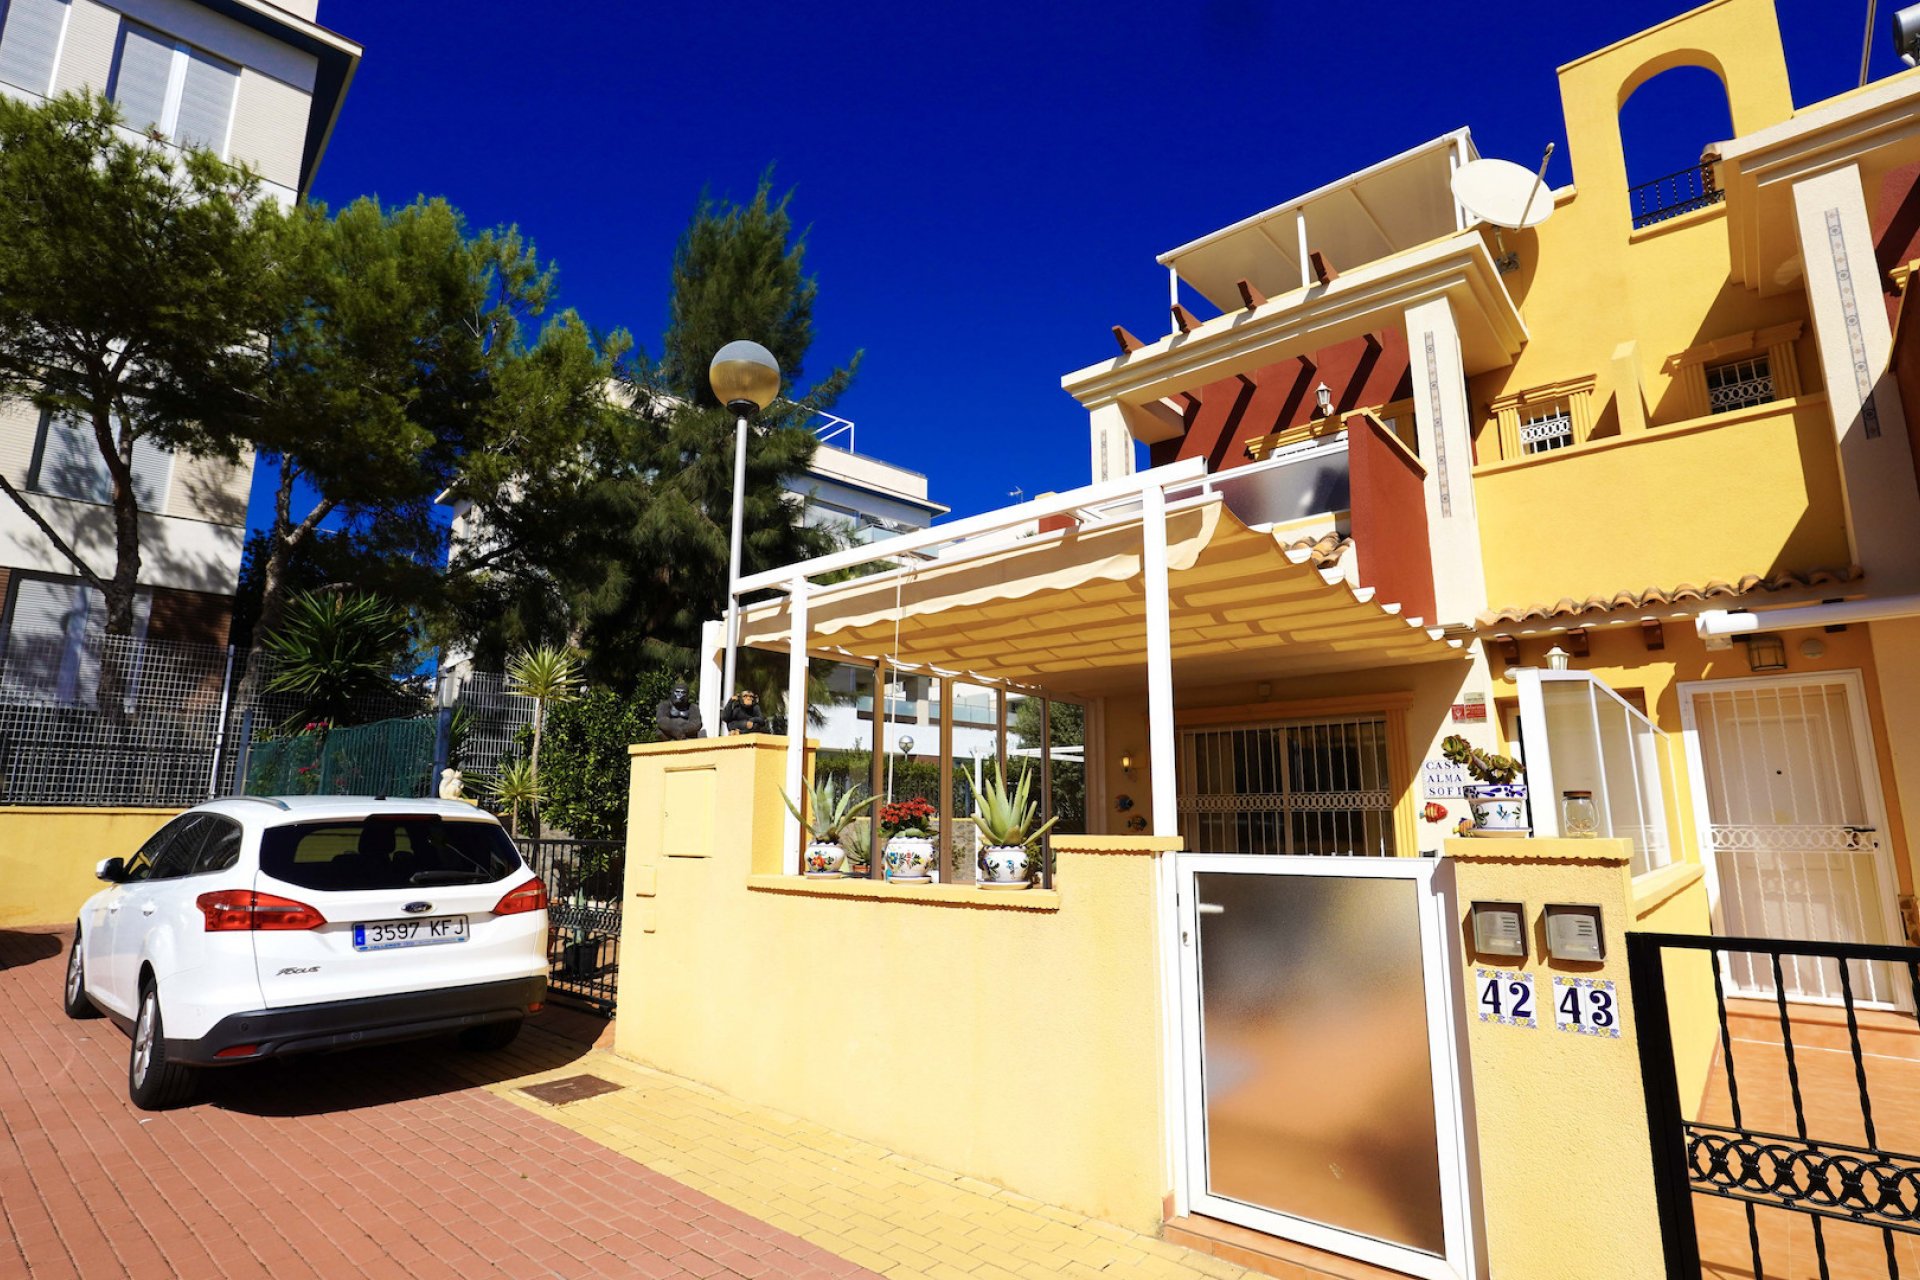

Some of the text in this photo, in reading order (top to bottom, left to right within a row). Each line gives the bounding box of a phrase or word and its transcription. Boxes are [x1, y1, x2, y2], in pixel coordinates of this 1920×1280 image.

[1425, 761, 1460, 770] CASA
[1428, 774, 1462, 783] ALMA
[372, 921, 420, 942] 3597
[430, 918, 464, 937] KFJ
[1481, 979, 1532, 1018] 42
[1559, 987, 1613, 1027] 43
